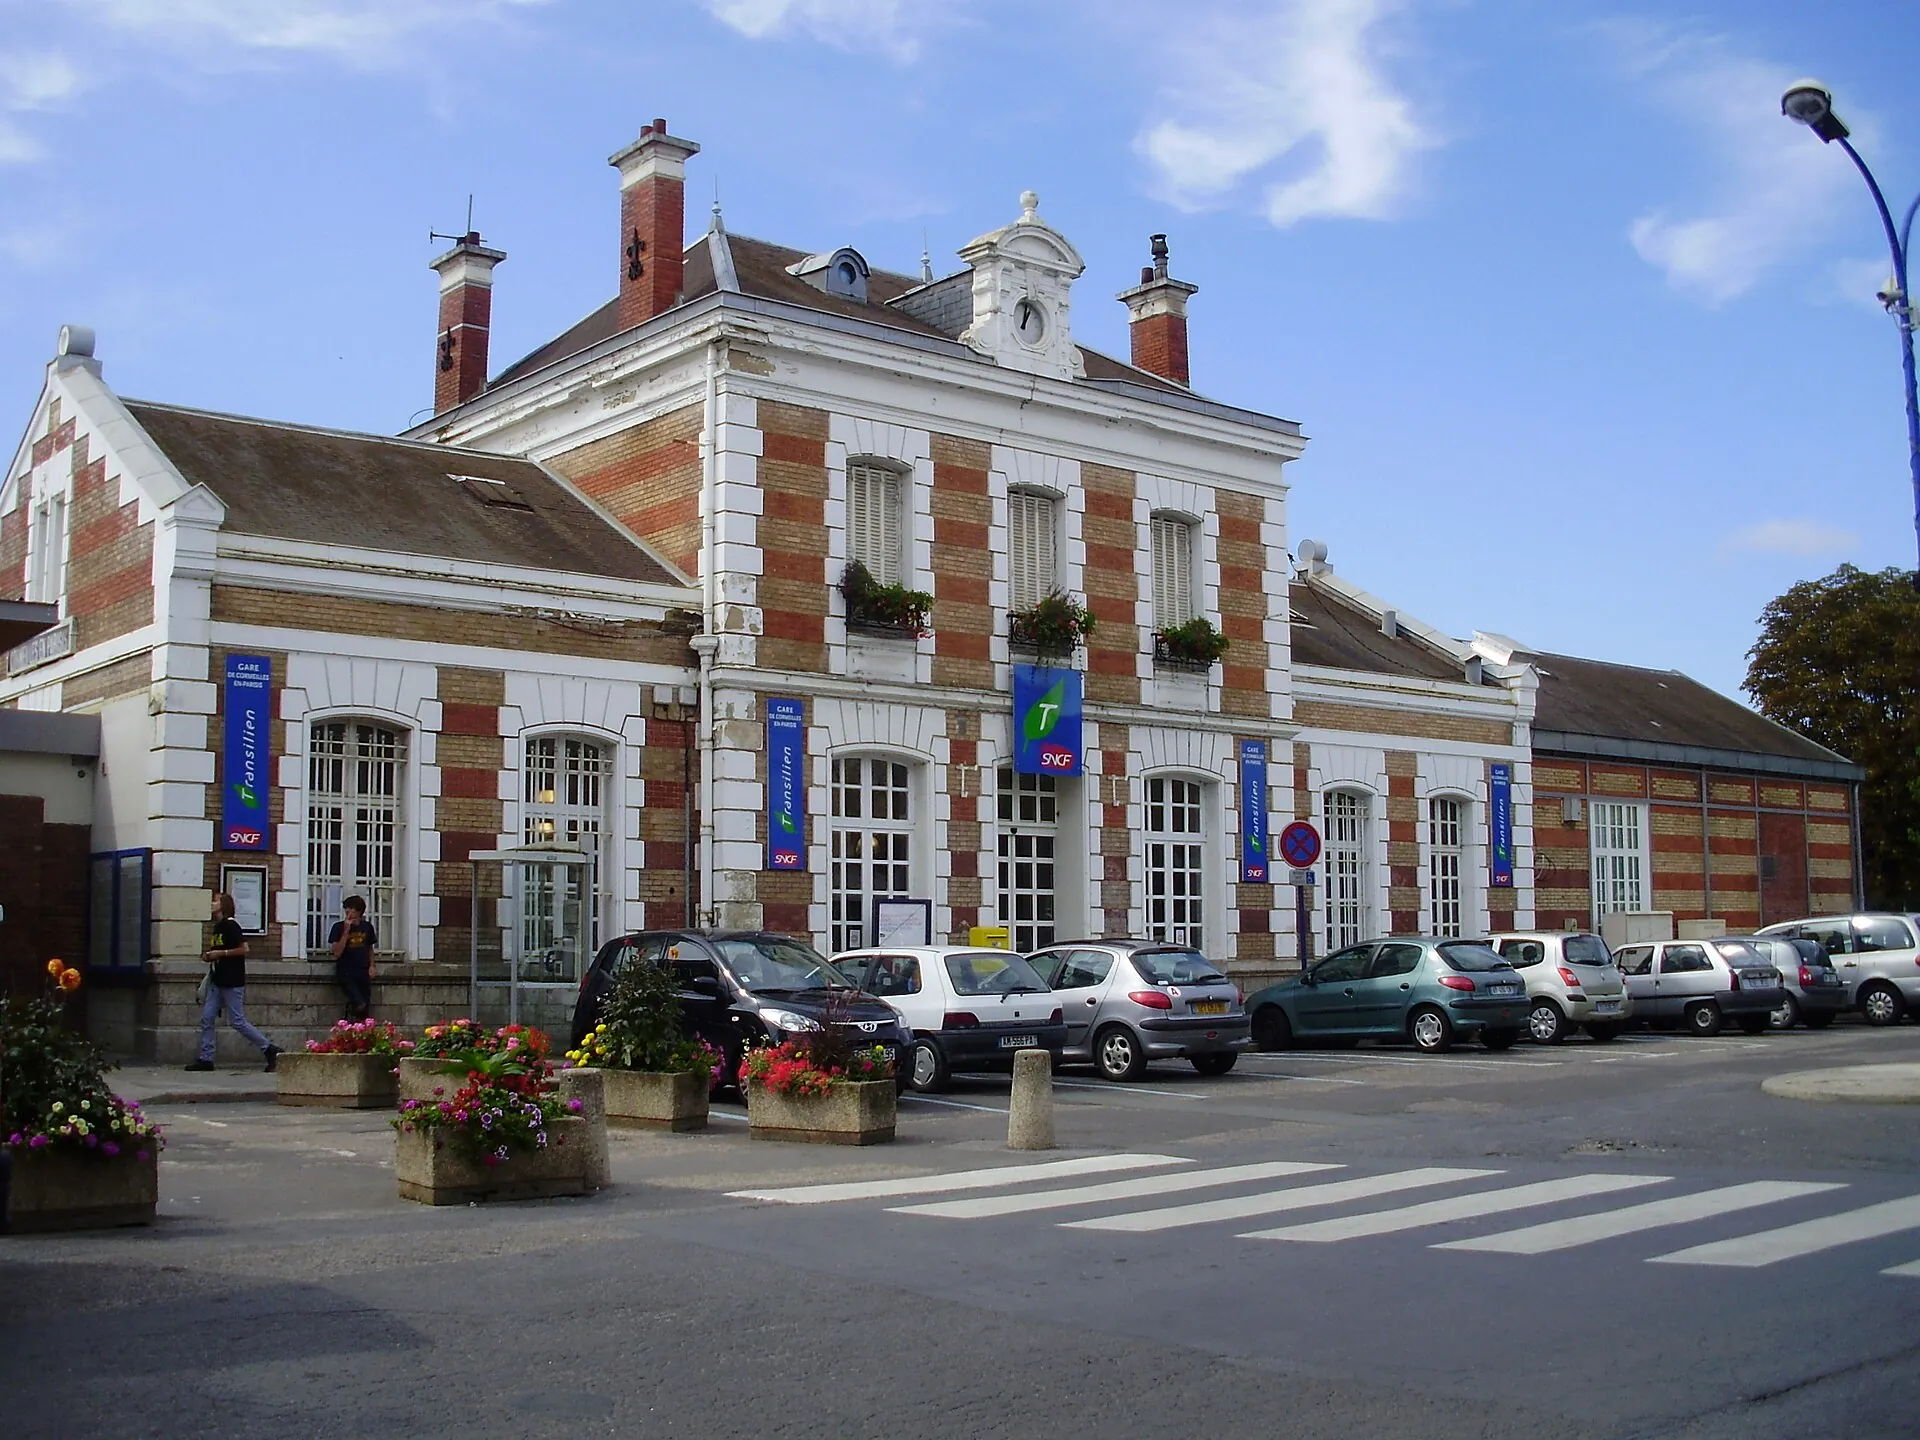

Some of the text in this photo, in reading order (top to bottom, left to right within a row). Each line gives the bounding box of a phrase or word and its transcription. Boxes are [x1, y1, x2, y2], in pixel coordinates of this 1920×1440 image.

[238, 663, 260, 672] GARE
[1039, 703, 1058, 731] T
[242, 709, 256, 800] Transilien
[1041, 752, 1073, 766] SNCF
[782, 747, 792, 825] Transilien
[1250, 780, 1259, 848] Transilien
[229, 832, 261, 844] SNCF
[774, 854, 798, 864] SNCF
[1247, 869, 1264, 878] SNCF
